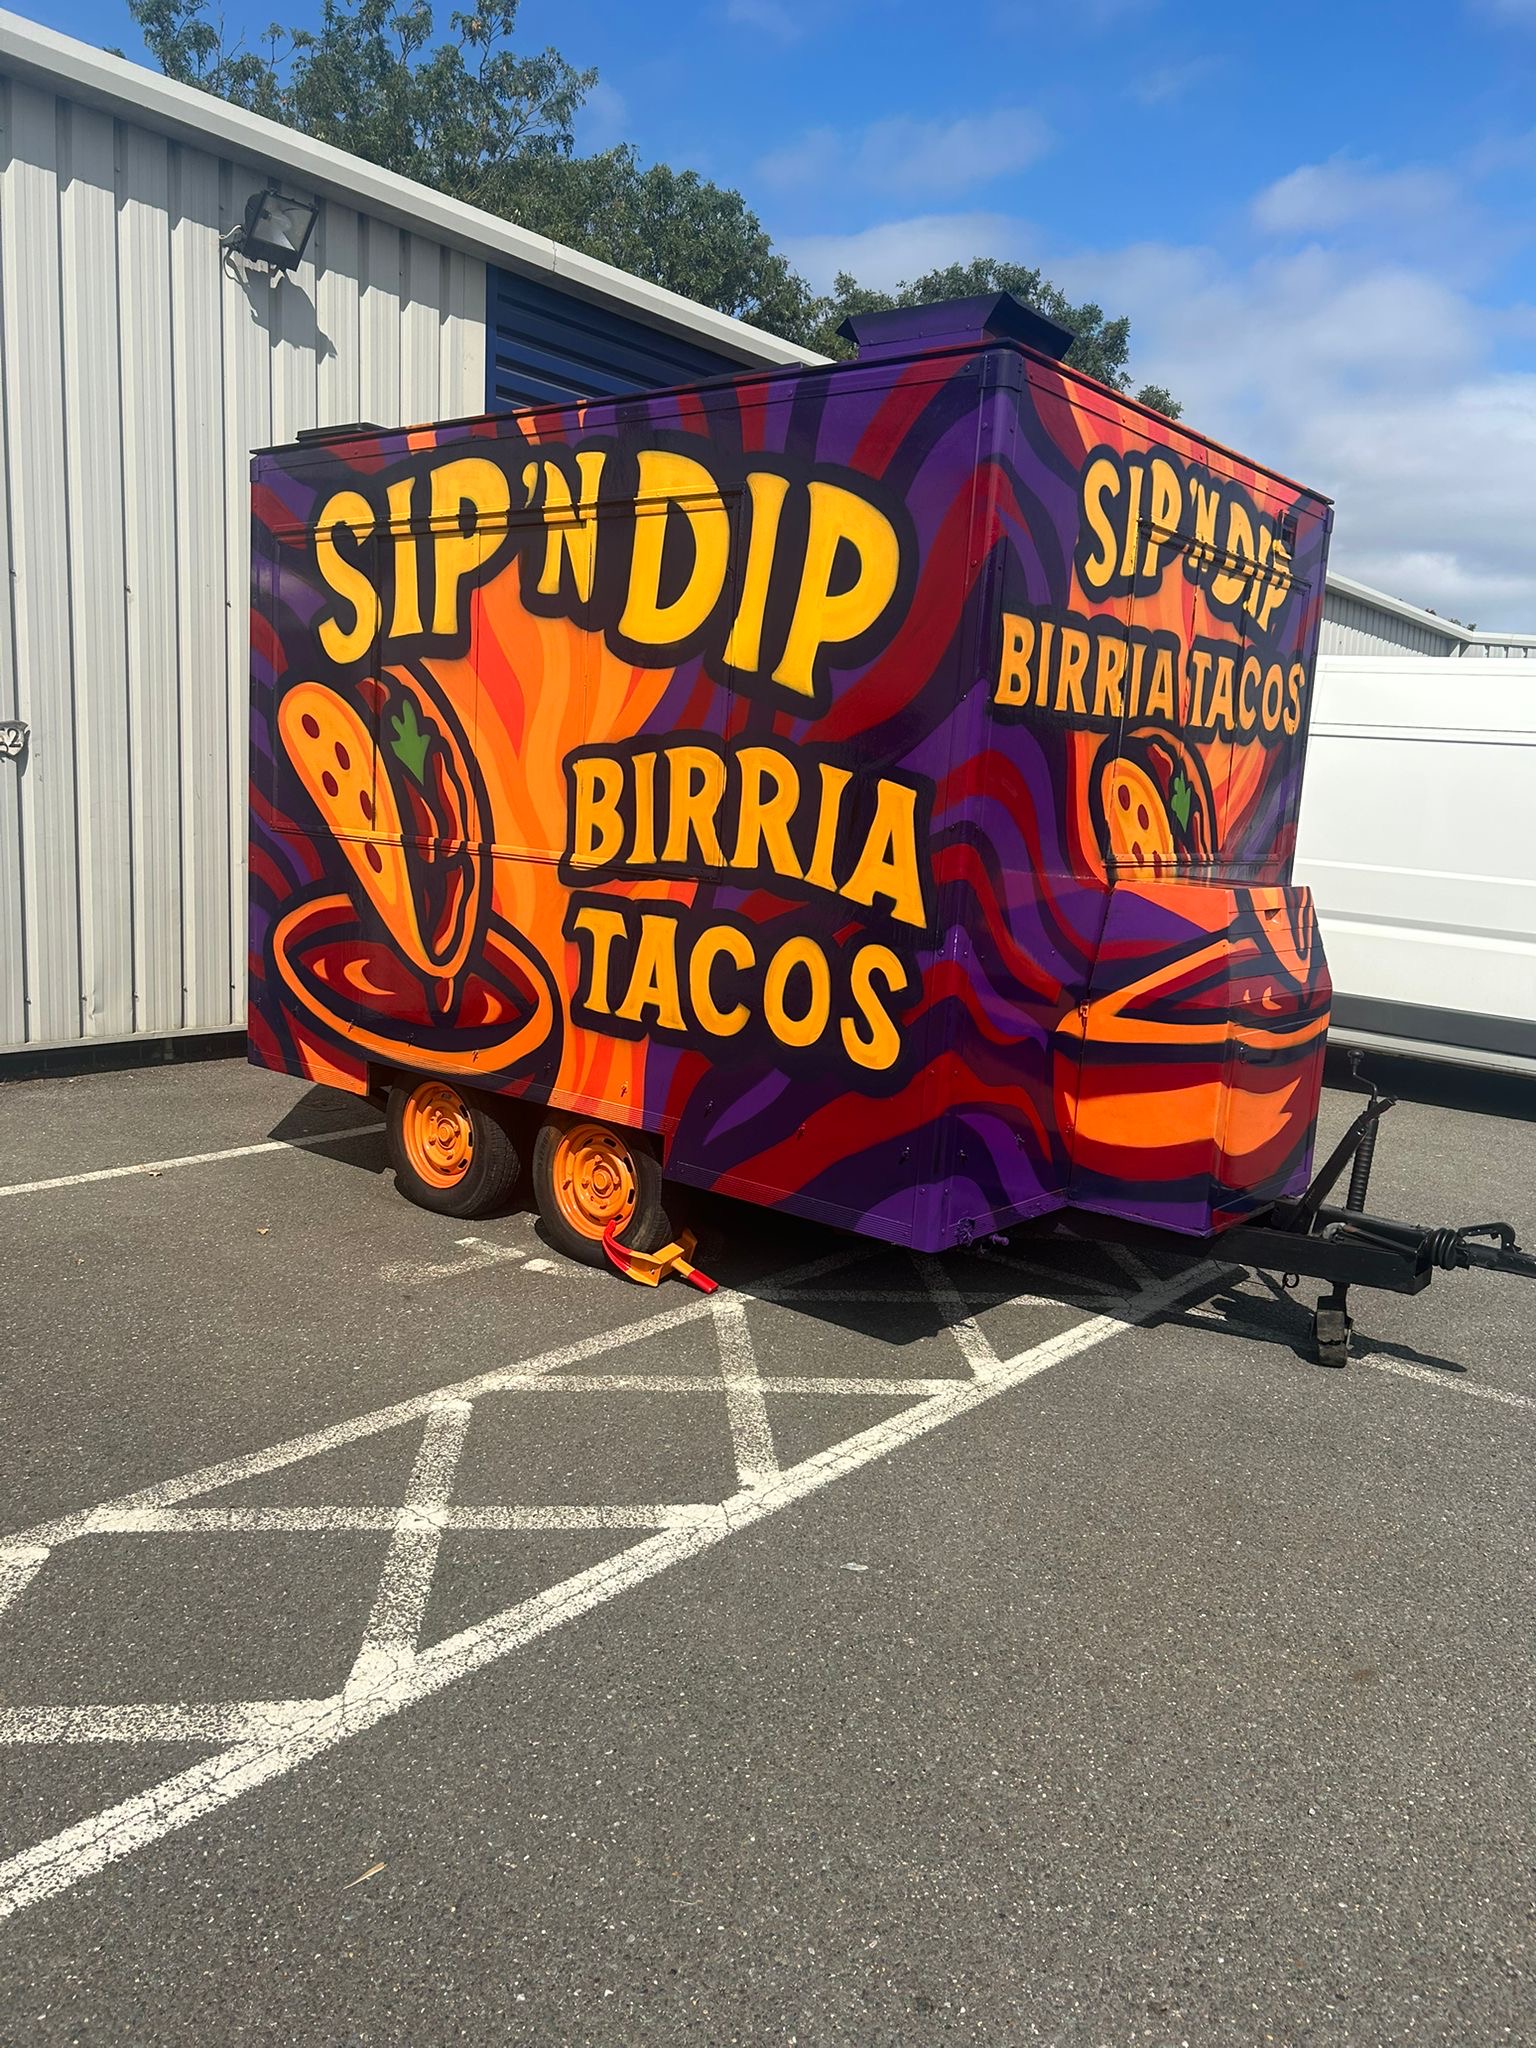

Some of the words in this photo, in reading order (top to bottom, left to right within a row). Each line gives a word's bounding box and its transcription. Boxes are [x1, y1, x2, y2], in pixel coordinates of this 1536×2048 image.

[618, 450, 900, 698] DIP
[1211, 501, 1293, 632] DIP
[993, 612, 1175, 722] BIRRIA
[1188, 651, 1306, 736] TACOS
[570, 746, 927, 928] BIRRIA
[574, 907, 908, 1071] TACOS
